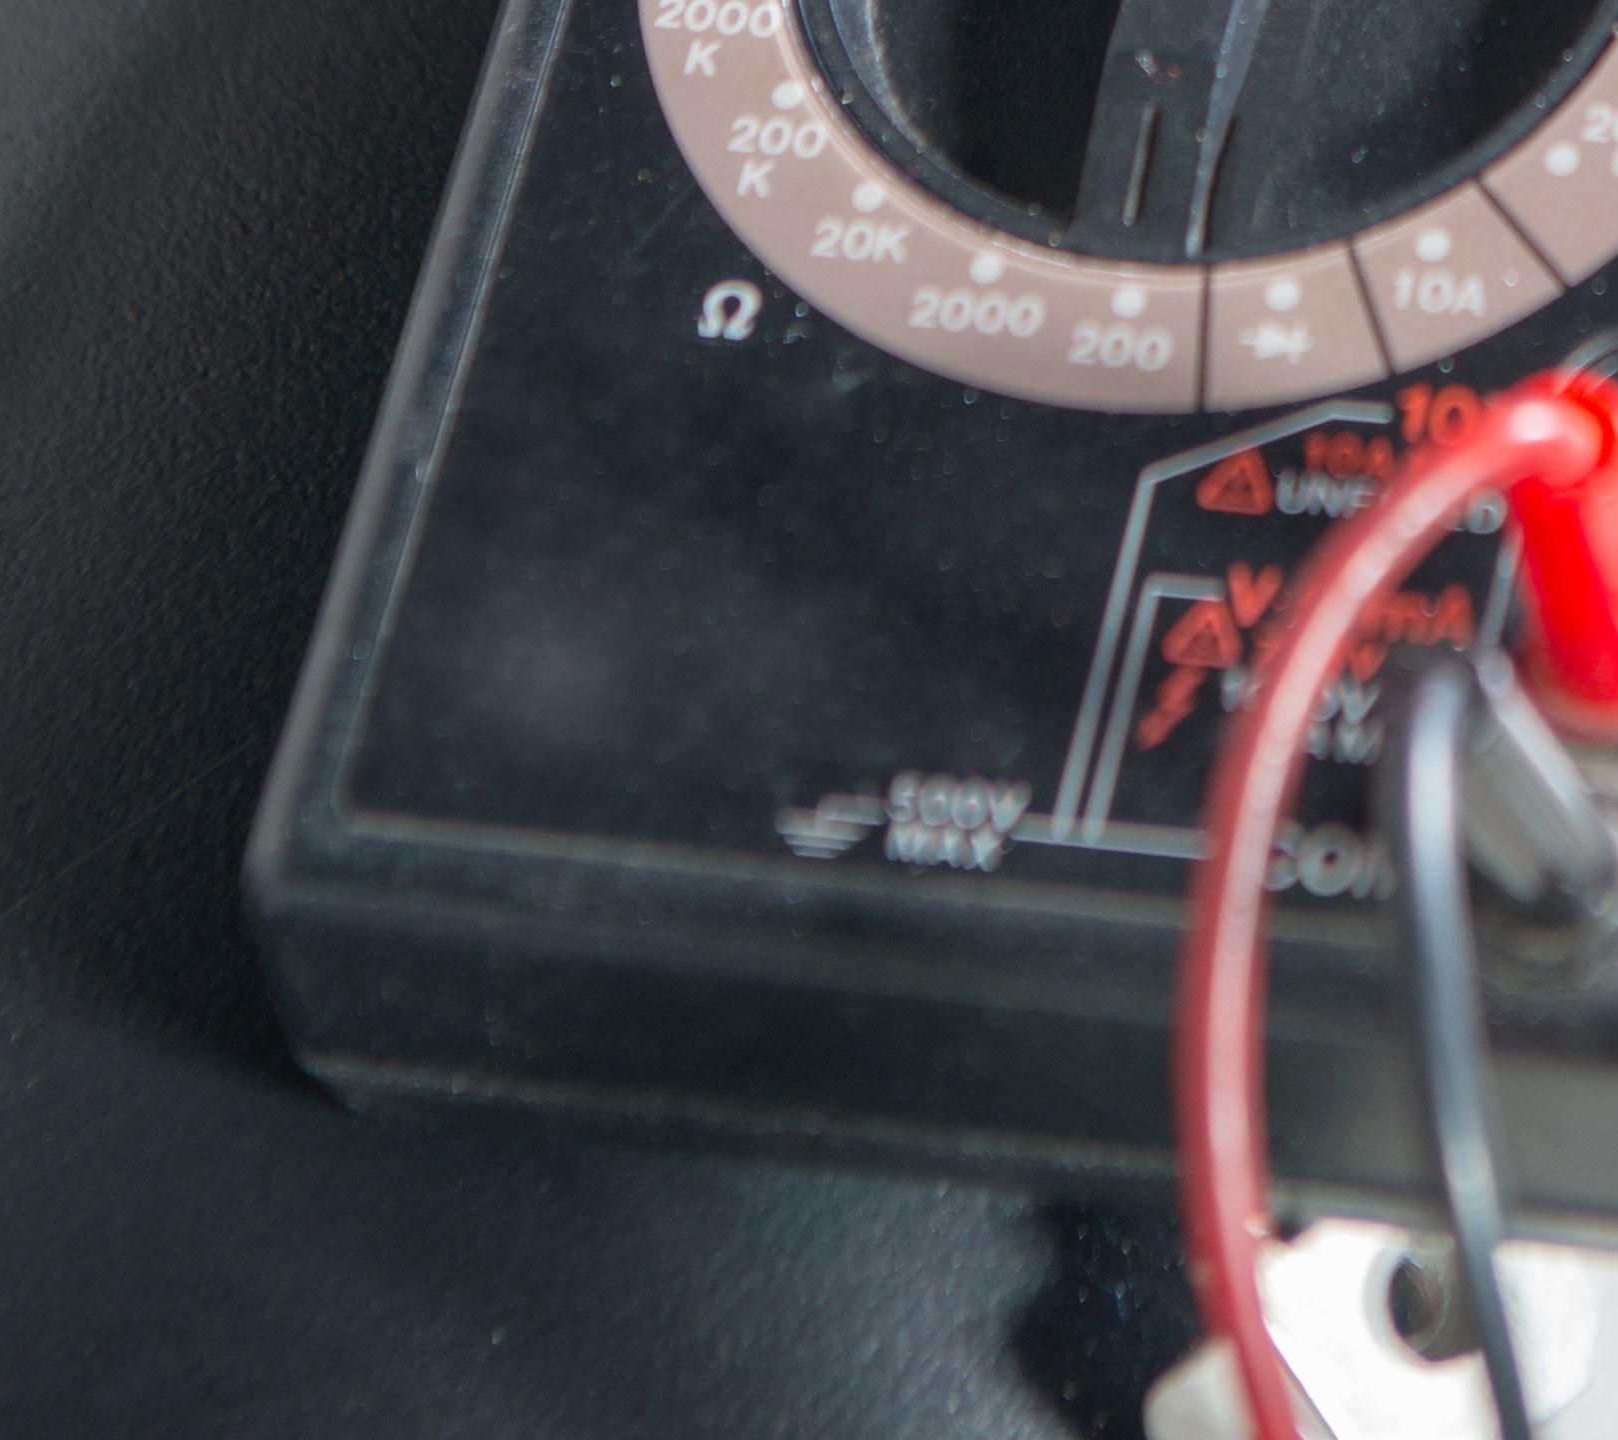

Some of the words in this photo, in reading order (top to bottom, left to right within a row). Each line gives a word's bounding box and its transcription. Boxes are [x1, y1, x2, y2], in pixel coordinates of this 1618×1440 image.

[685, 41, 719, 76] K
[728, 118, 828, 158] 200
[738, 161, 774, 197] K
[811, 220, 909, 263] 20K
[910, 288, 1044, 336] 2000
[1395, 271, 1484, 315] 10A
[1069, 323, 1172, 370] 200
[886, 772, 1032, 833] 500V
